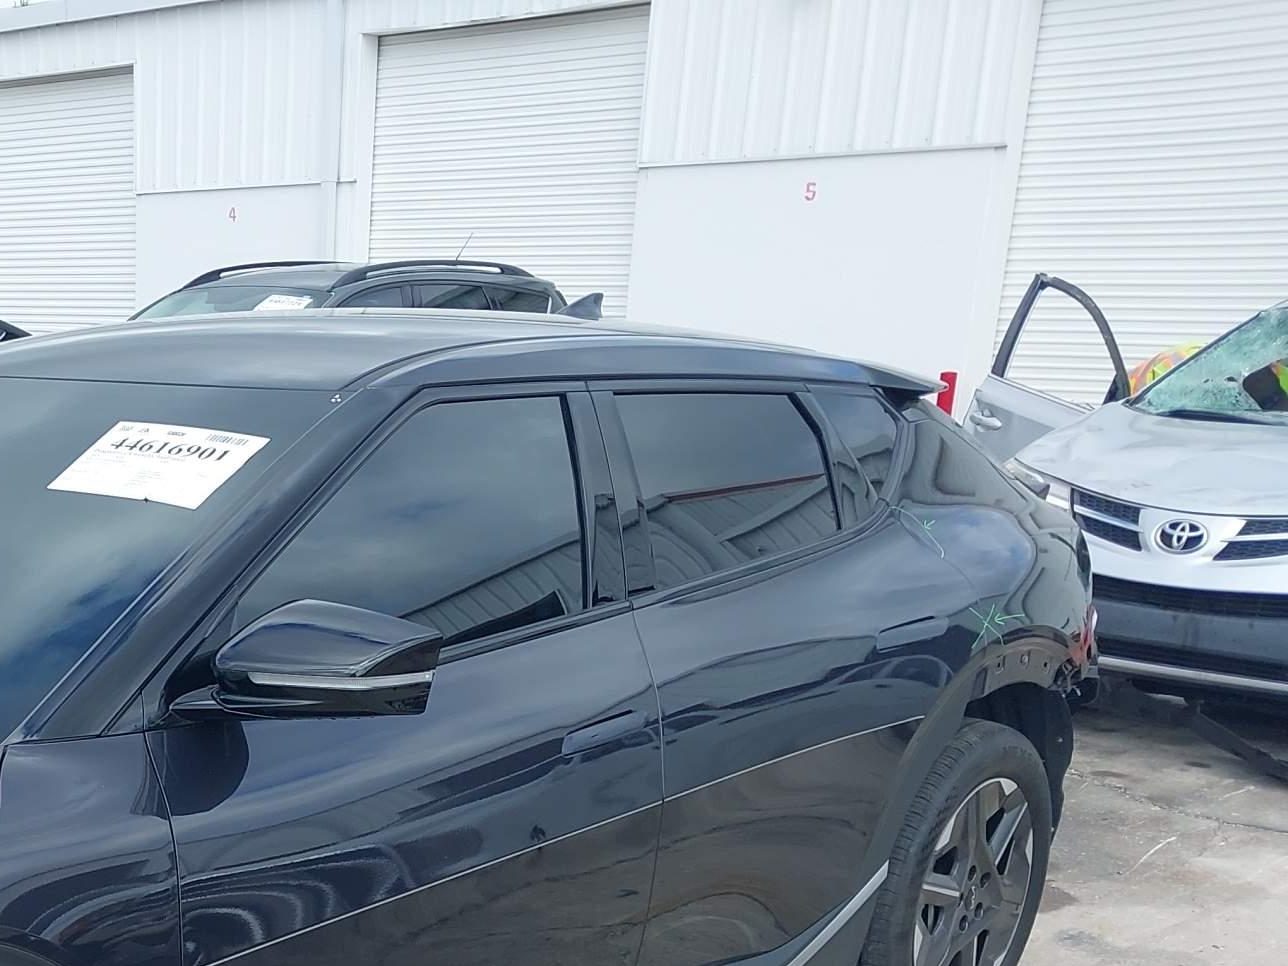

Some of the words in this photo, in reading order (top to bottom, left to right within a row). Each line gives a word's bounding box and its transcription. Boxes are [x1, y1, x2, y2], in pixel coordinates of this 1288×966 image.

[804, 182, 816, 201] 5
[228, 206, 237, 222] 4
[110, 436, 232, 462] 44616901
